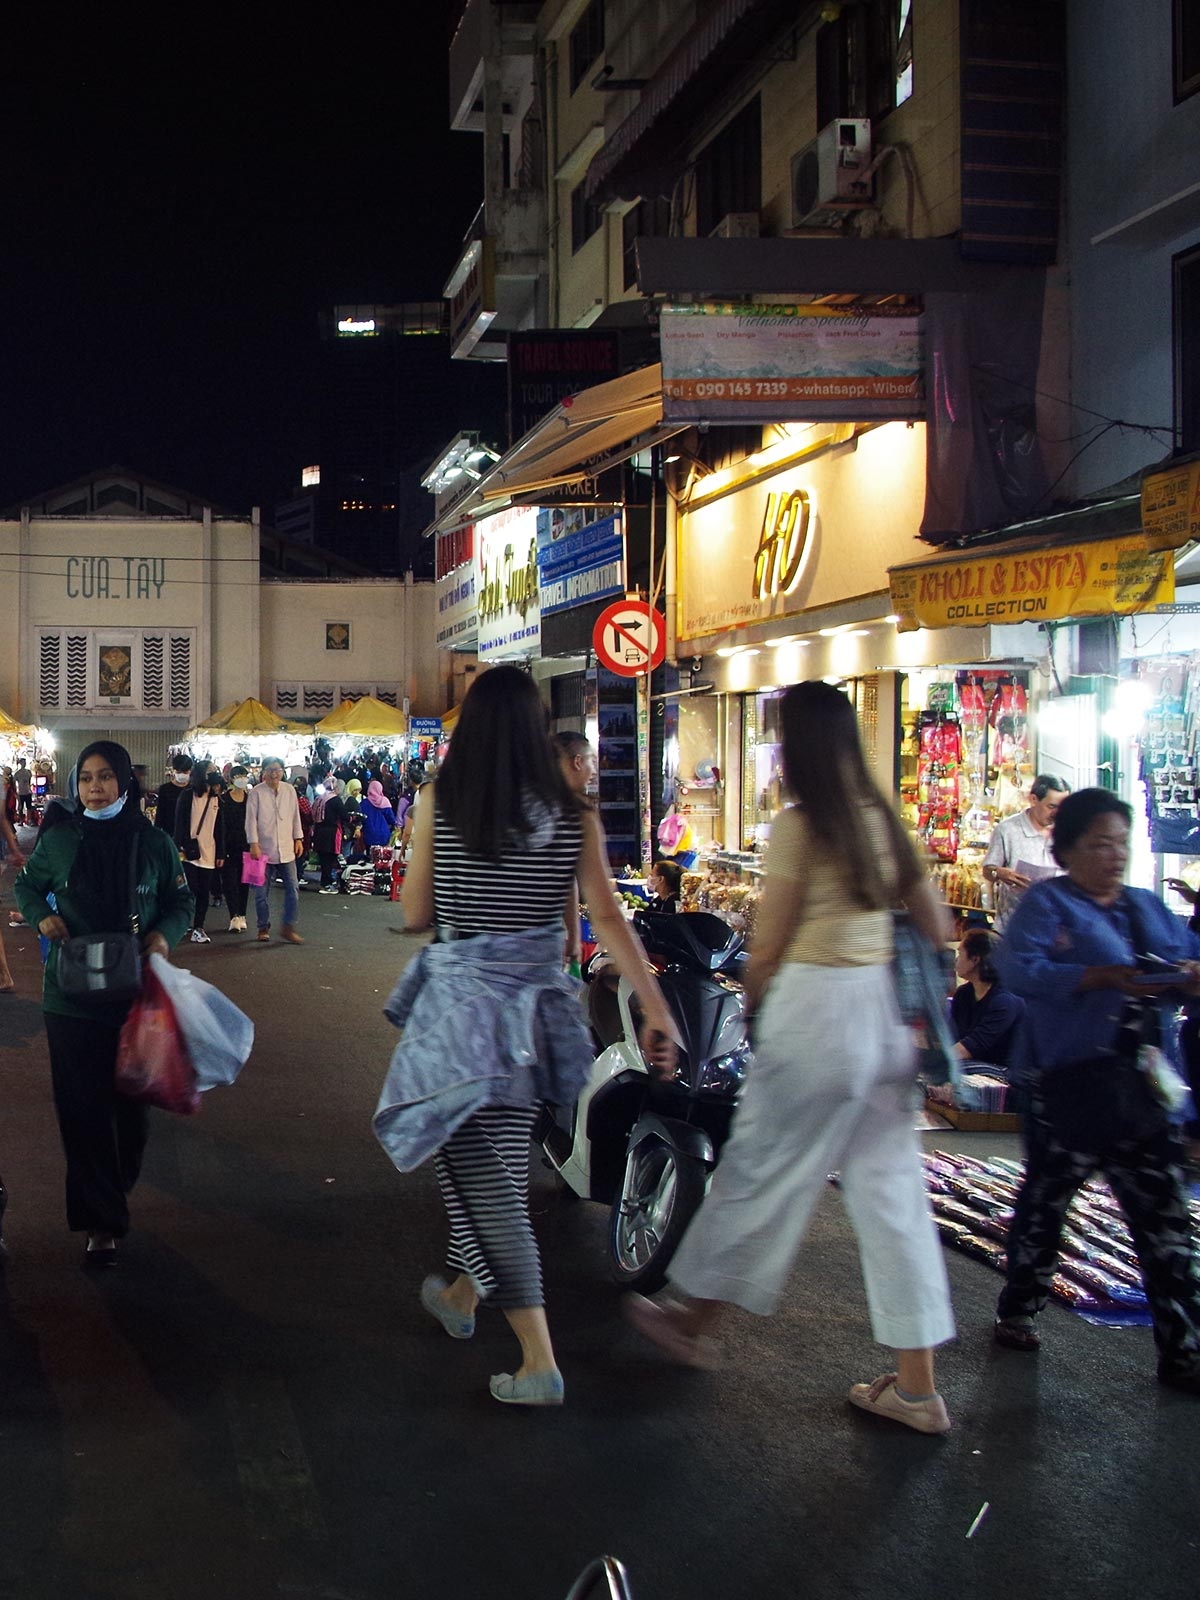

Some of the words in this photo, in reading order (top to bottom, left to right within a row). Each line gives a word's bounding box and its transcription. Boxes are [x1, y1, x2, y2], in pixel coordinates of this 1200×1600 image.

[695, 384, 724, 396] 090
[729, 383, 751, 395] 145
[756, 382, 788, 395] 7339
[919, 563, 985, 603] KHOLI
[990, 562, 1008, 596] &
[1010, 552, 1088, 593] ESITA
[540, 581, 565, 610] TRAVEL
[946, 597, 1048, 619] COLLECTION
